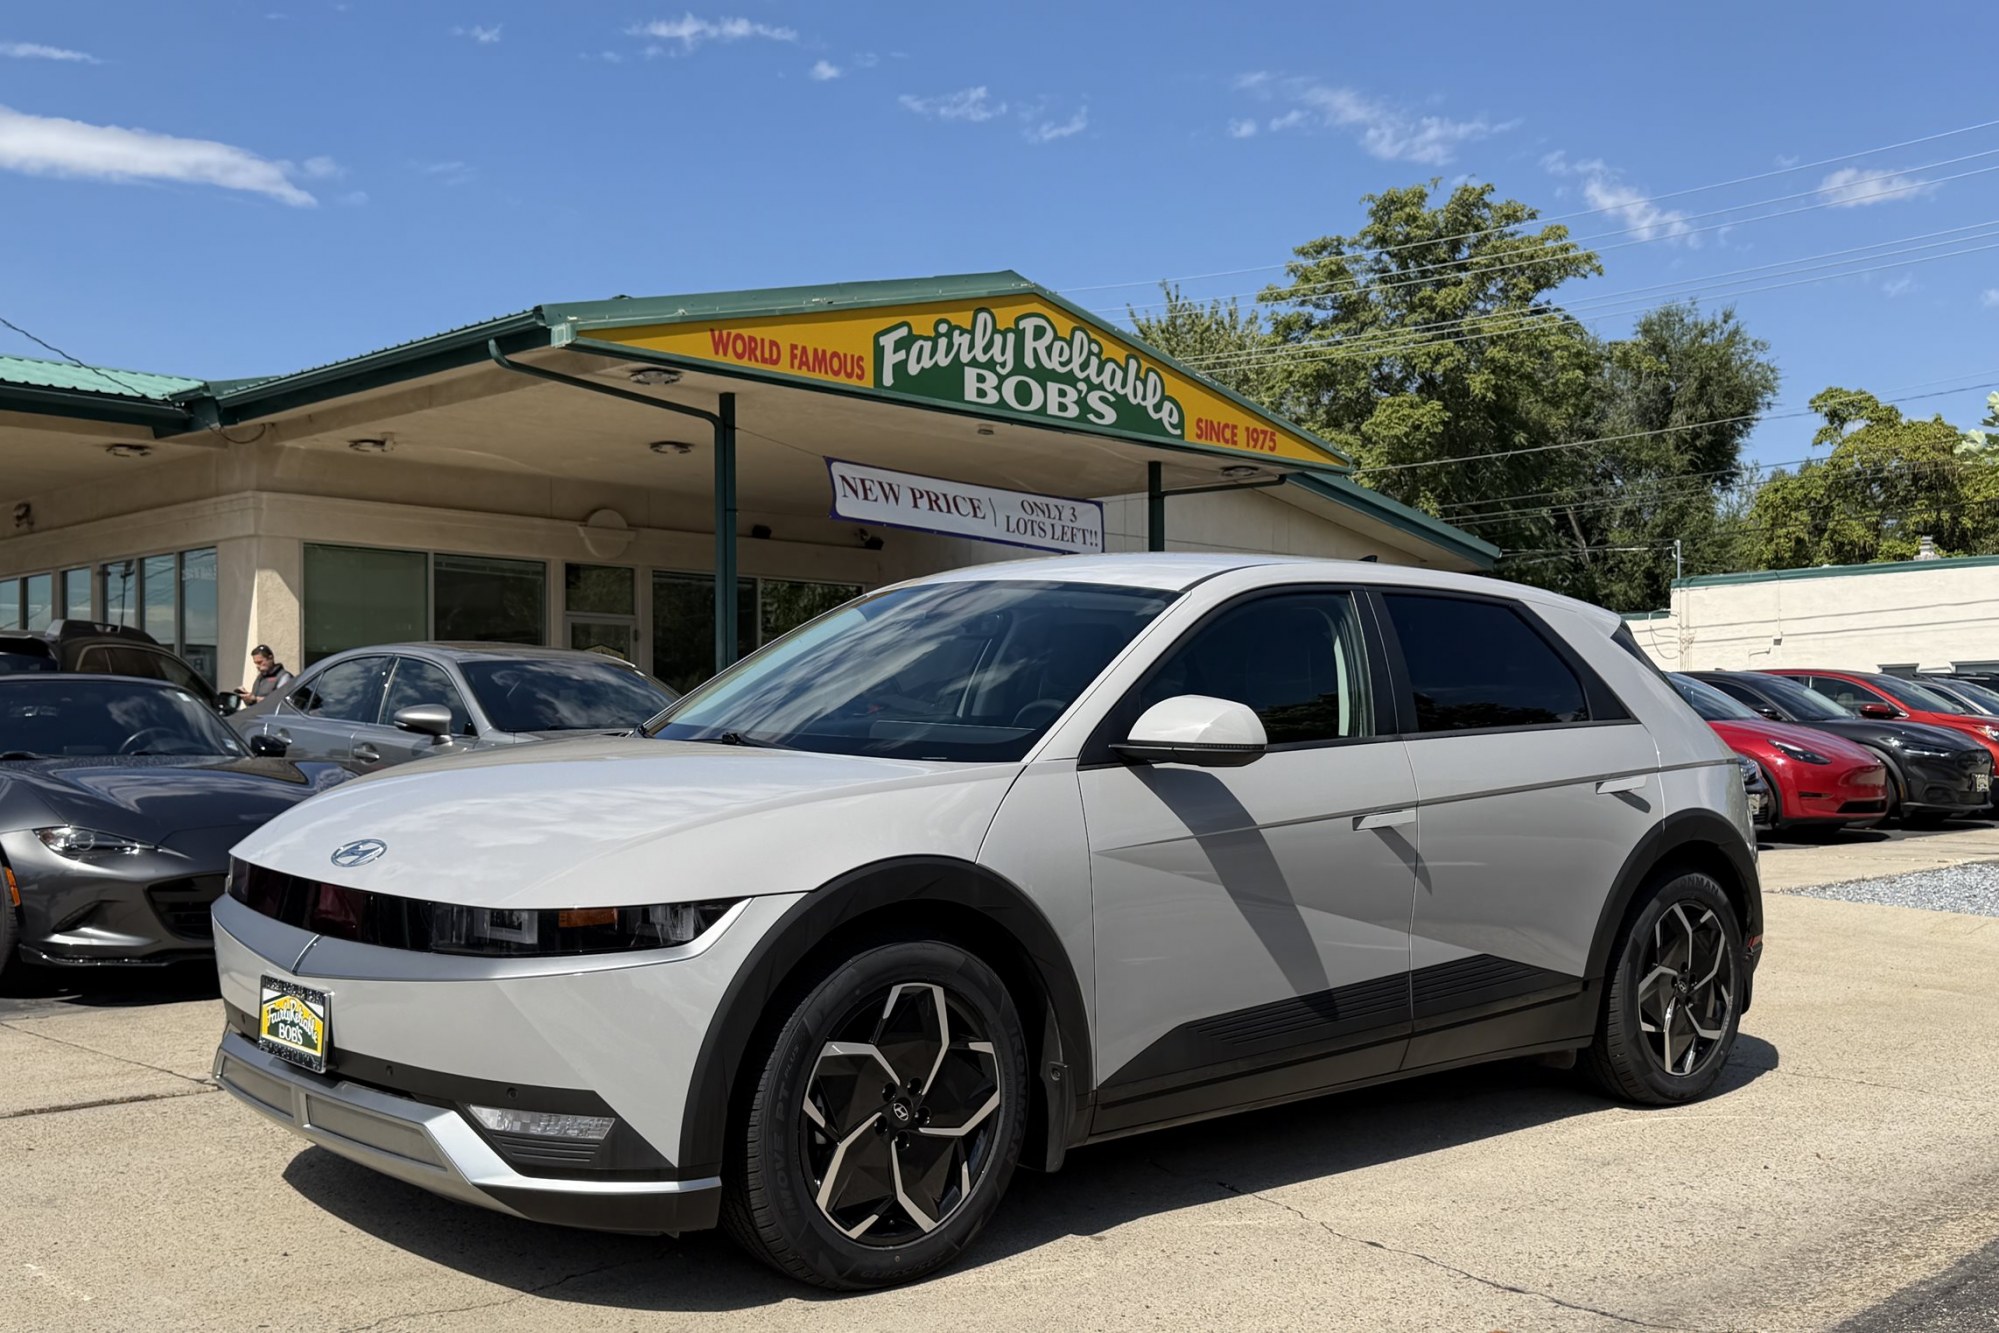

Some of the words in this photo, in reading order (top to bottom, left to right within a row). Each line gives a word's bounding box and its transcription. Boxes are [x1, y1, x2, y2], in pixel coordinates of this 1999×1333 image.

[709, 328, 782, 366] WORLD
[789, 343, 865, 381] FAMOUS
[879, 311, 1016, 387] Fairly
[1018, 316, 1182, 435] Reliable
[964, 366, 1117, 425] BOB'S
[1195, 417, 1238, 446] SINCE
[1244, 426, 1277, 452] 1975
[839, 474, 901, 506] NEW
[907, 486, 987, 520] PRICE
[1020, 499, 1065, 521] ONLY
[1069, 506, 1078, 523] 3
[1005, 515, 1047, 539] LOTS
[1050, 523, 1098, 547] LEFT!!
[267, 1001, 291, 1026] Fairly
[290, 1000, 318, 1044] Reliable
[278, 1022, 303, 1045] BOB'S
